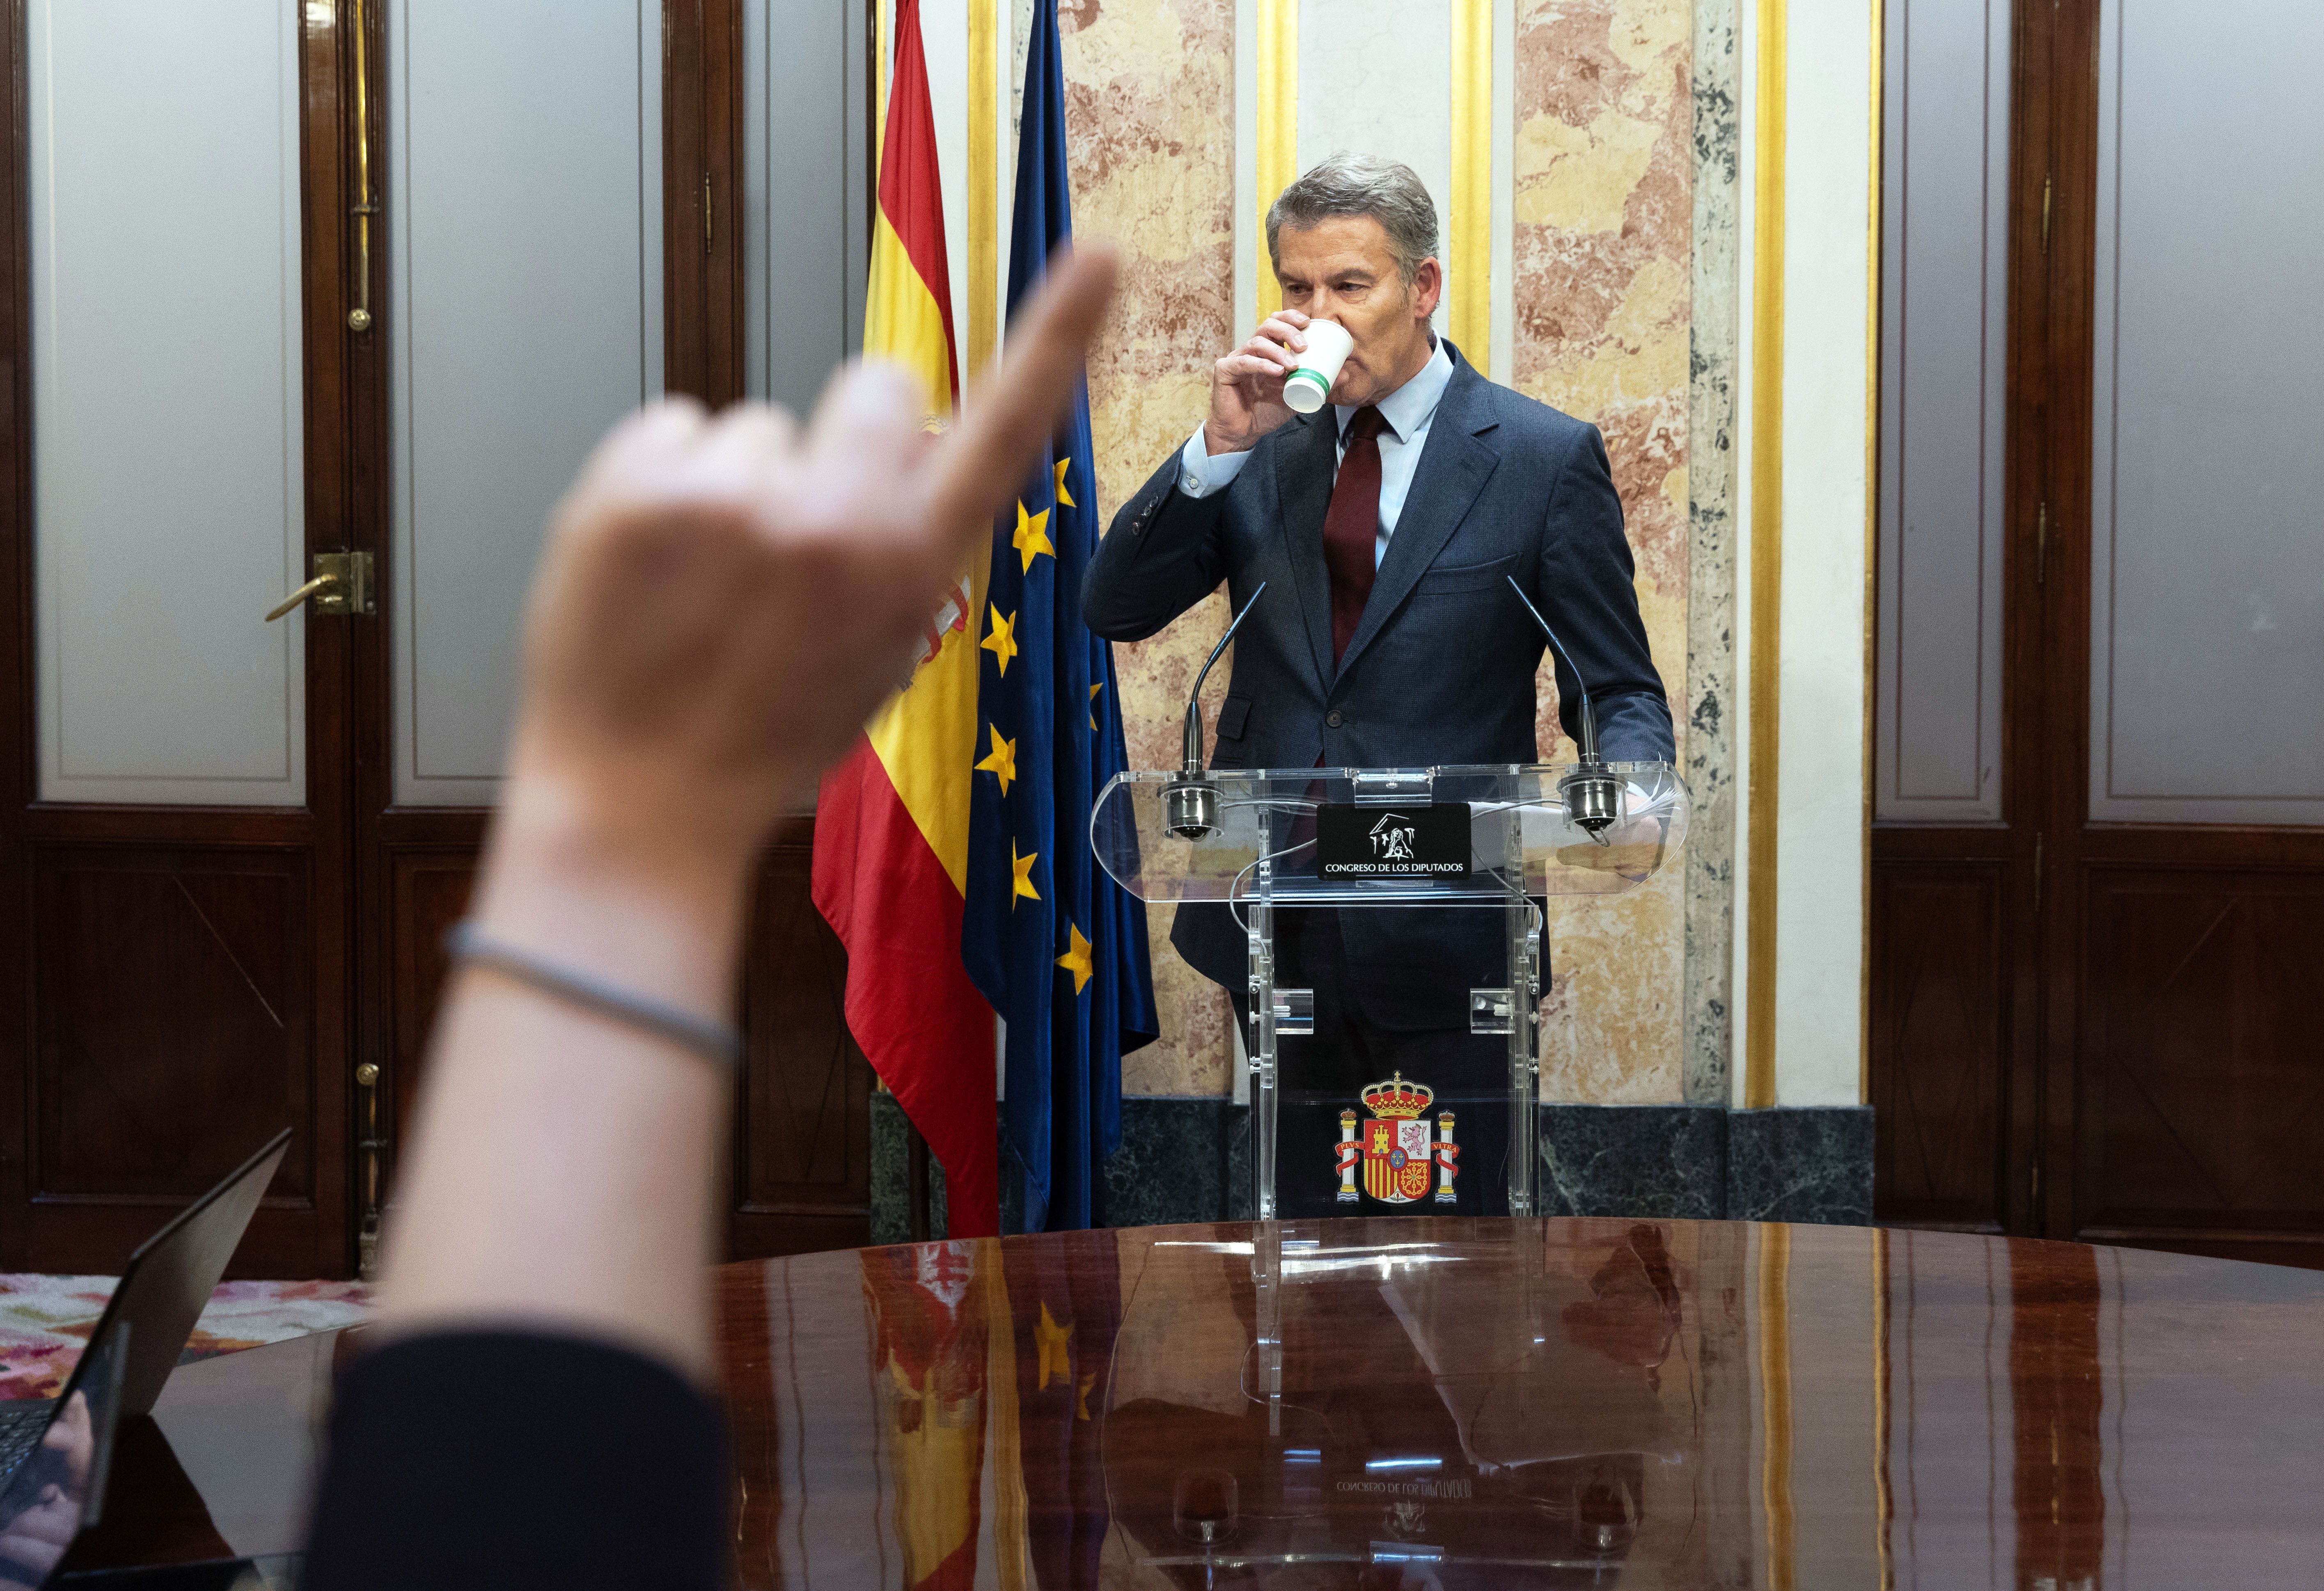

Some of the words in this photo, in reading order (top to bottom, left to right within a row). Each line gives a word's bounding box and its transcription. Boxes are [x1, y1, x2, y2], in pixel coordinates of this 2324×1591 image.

[1325, 863, 1376, 872] CONGRESO
[1378, 863, 1390, 872] DE
[1392, 863, 1409, 872] LOS
[1412, 863, 1463, 872] DIPUTADOS
[1433, 1143, 1457, 1153] VLTRA
